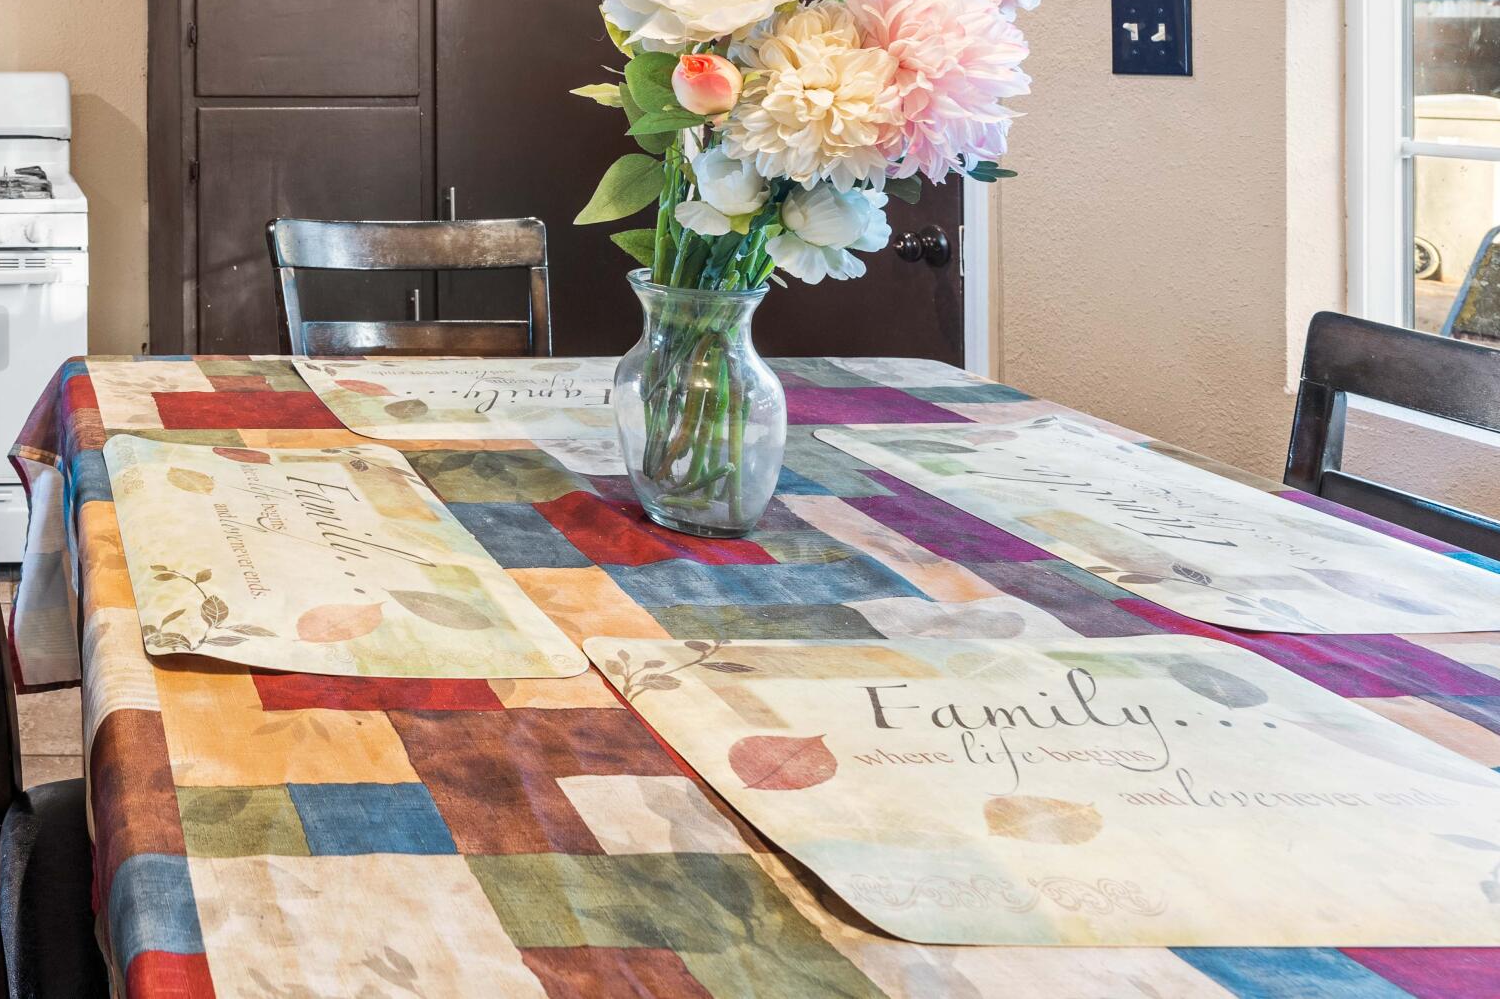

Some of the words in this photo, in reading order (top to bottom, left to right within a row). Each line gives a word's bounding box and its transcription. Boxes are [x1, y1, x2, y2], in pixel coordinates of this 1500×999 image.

[853, 748, 955, 766] where
[960, 727, 1044, 797] life
[1037, 746, 1157, 768] begins
[1116, 787, 1189, 806] and
[1176, 768, 1274, 808] love
